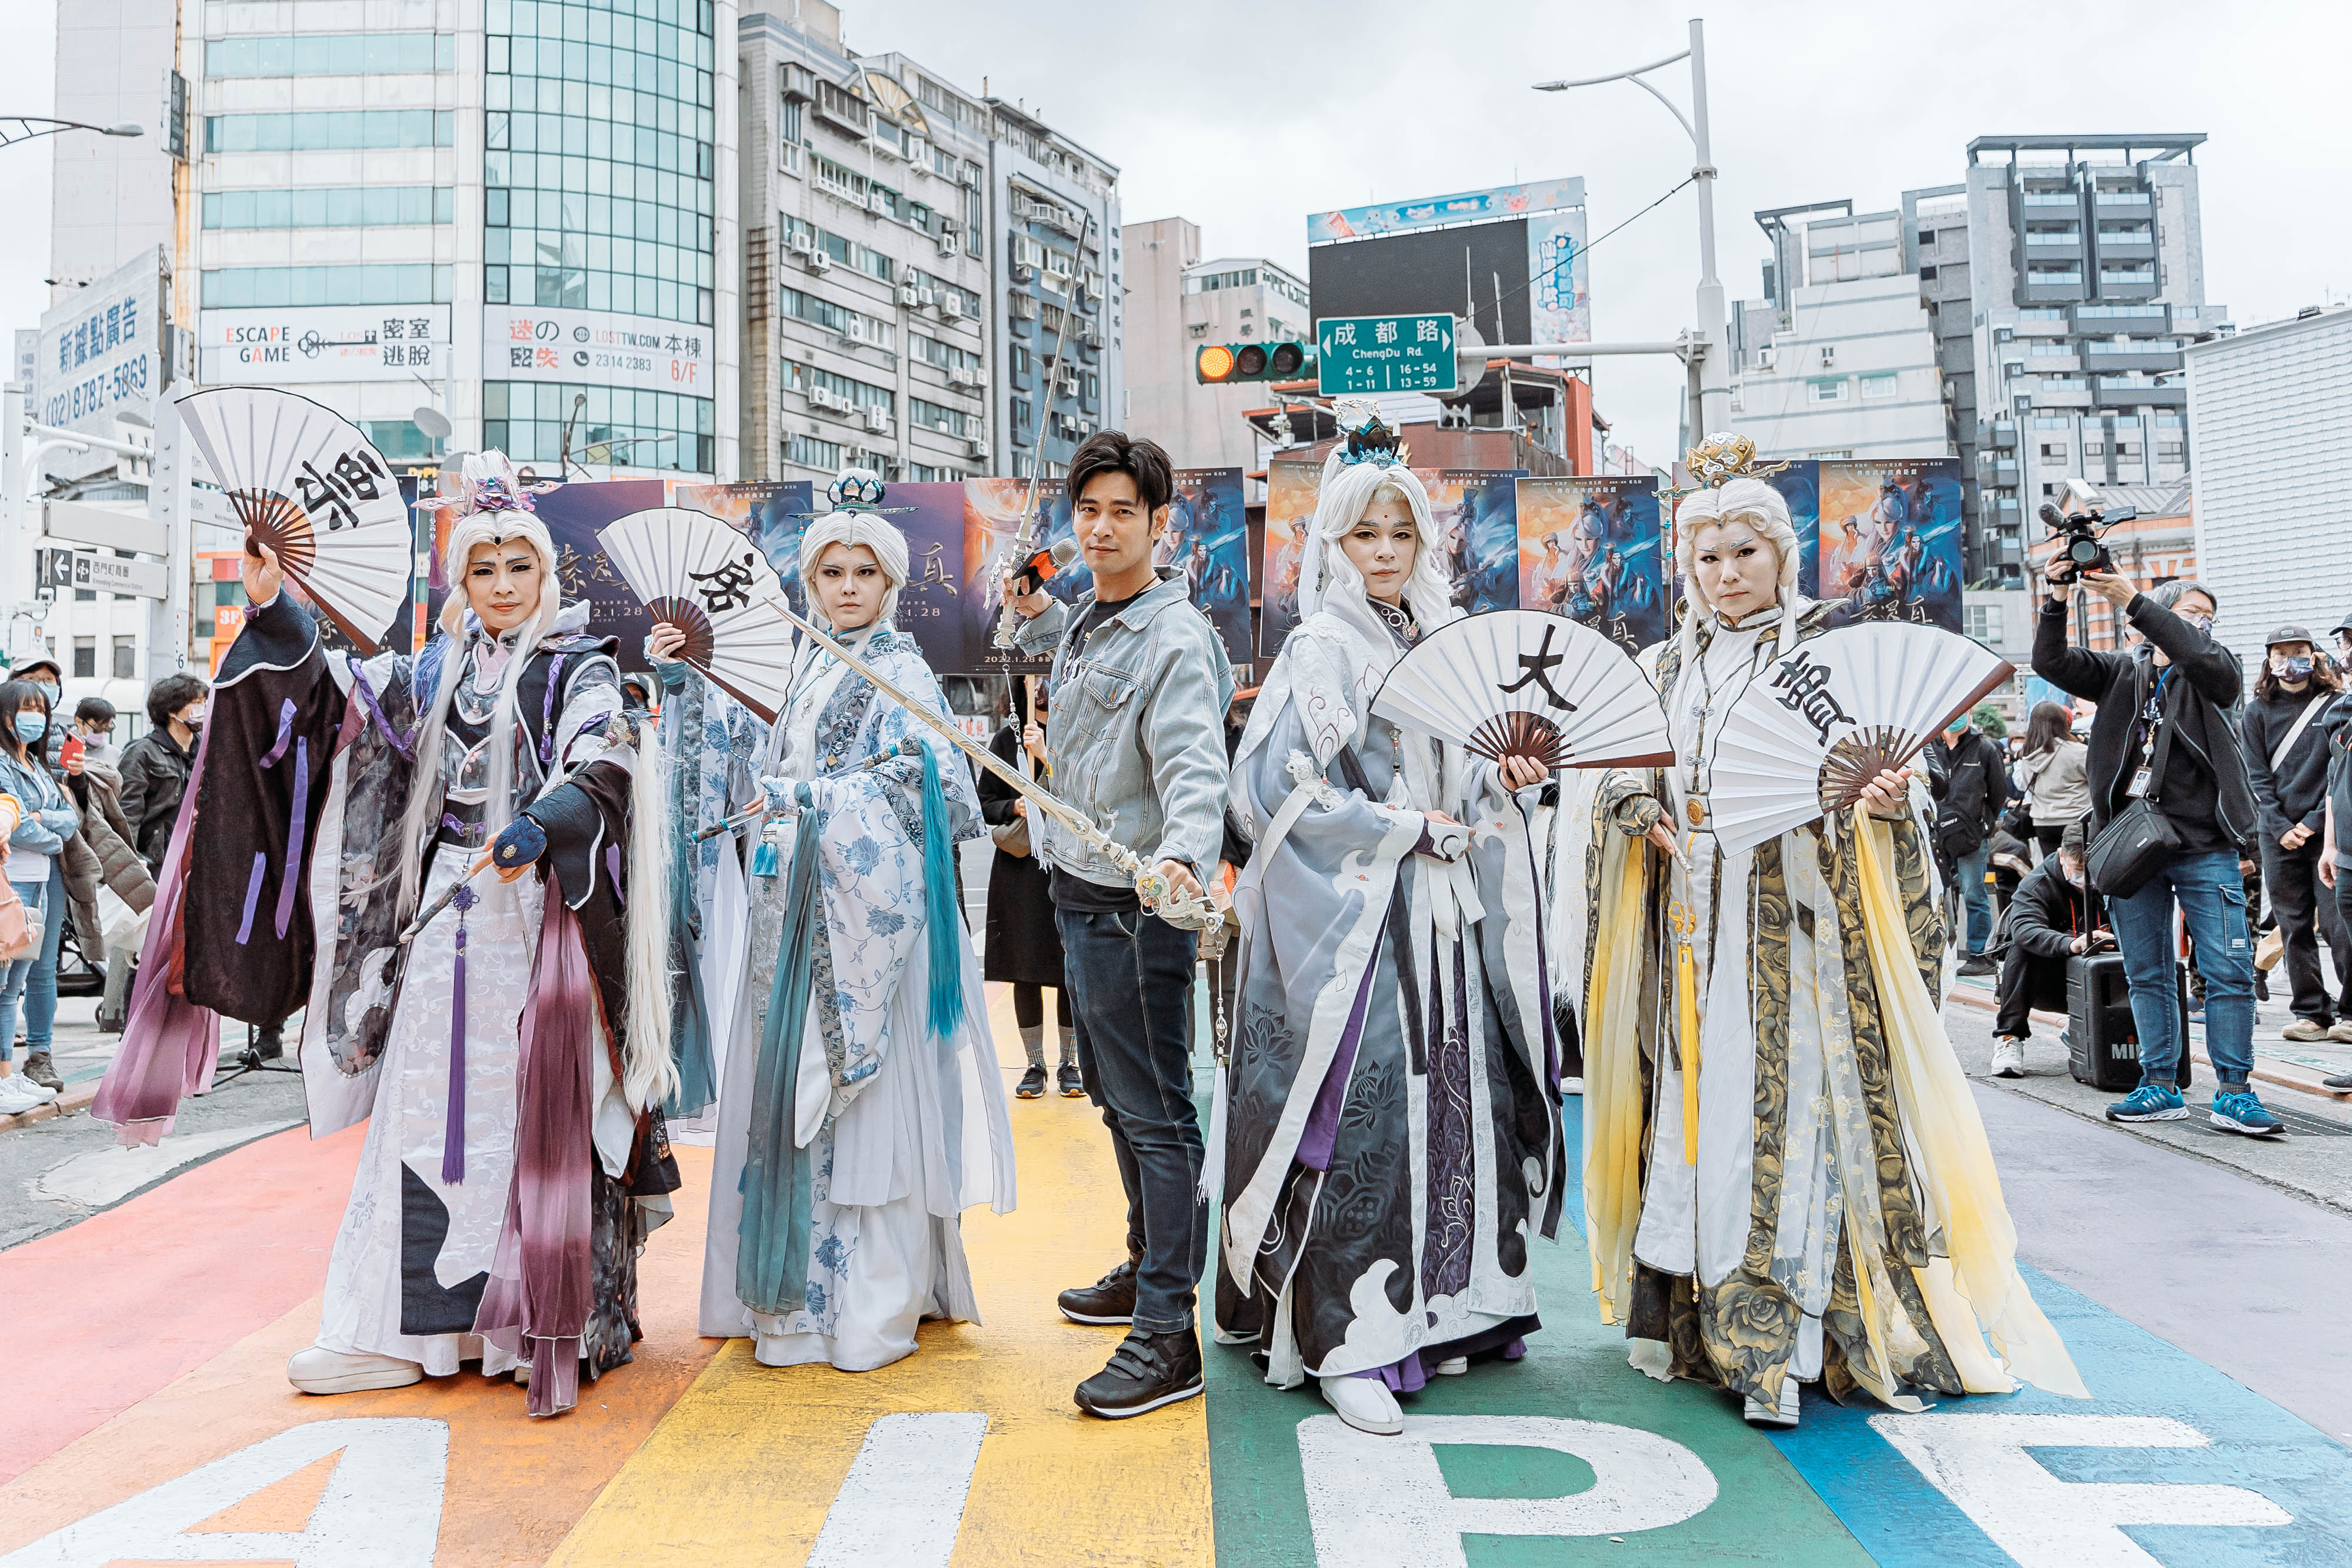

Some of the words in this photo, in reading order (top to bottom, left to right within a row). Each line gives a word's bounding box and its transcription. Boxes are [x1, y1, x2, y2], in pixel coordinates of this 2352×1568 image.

[59, 296, 137, 374] 新據點廣告
[226, 326, 290, 343] ESCAPE
[383, 318, 430, 340] 密室
[596, 329, 660, 349] LOSTTW.COM
[1334, 320, 1439, 345] 成都路
[240, 347, 290, 363] GAME
[383, 345, 430, 366] 逃脫
[665, 333, 701, 358] 本棟
[1352, 348, 1400, 360] ChengDu
[1407, 347, 1424, 356] Rd.
[596, 355, 623, 367] 2314
[626, 357, 652, 372] 2383
[46, 353, 146, 427] (02)8787-5869
[295, 450, 386, 531] 票
[688, 553, 754, 613] 房
[219, 610, 240, 625] 3F
[1496, 624, 1578, 713] 大
[1769, 651, 1856, 747] 賣
